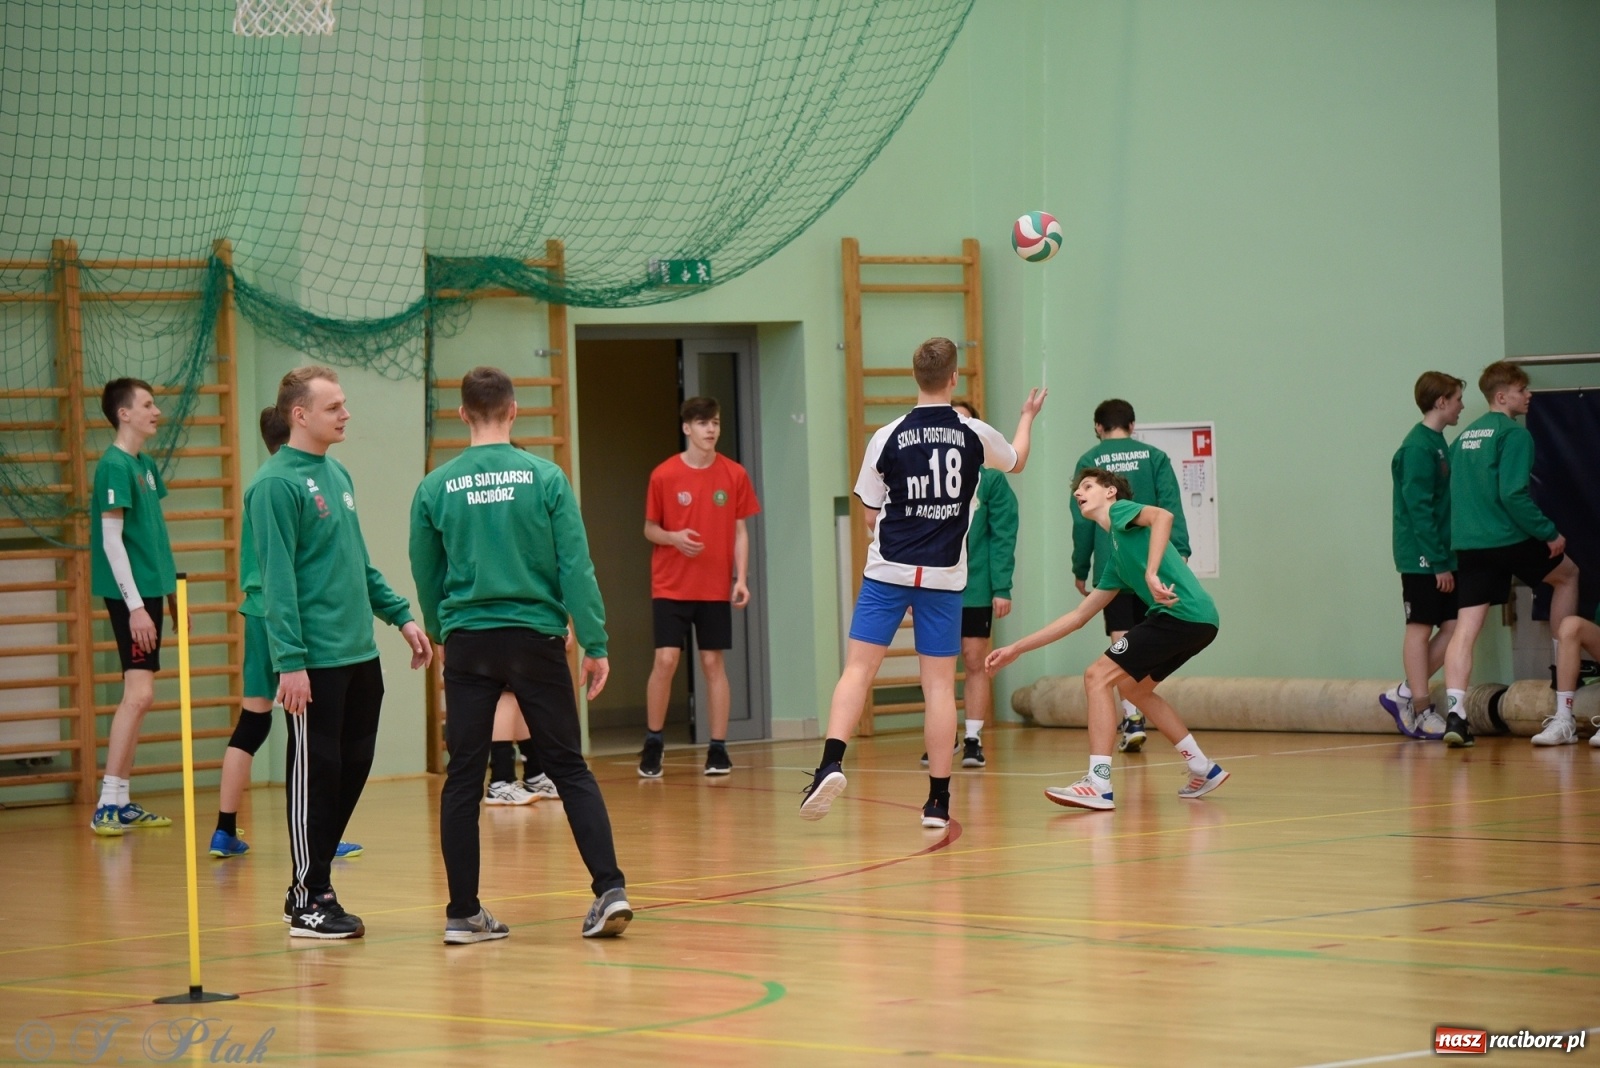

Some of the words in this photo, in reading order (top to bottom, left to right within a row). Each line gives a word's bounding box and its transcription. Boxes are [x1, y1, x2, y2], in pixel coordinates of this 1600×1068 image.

[897, 428, 921, 450] SZKOŁA
[923, 427, 965, 448] PODSTAWOWA
[1111, 450, 1149, 462] SIATKARSKI
[445, 475, 473, 493] KLUB
[475, 470, 533, 487] SIATKARSKI
[467, 486, 515, 505] RACIBÓRZ
